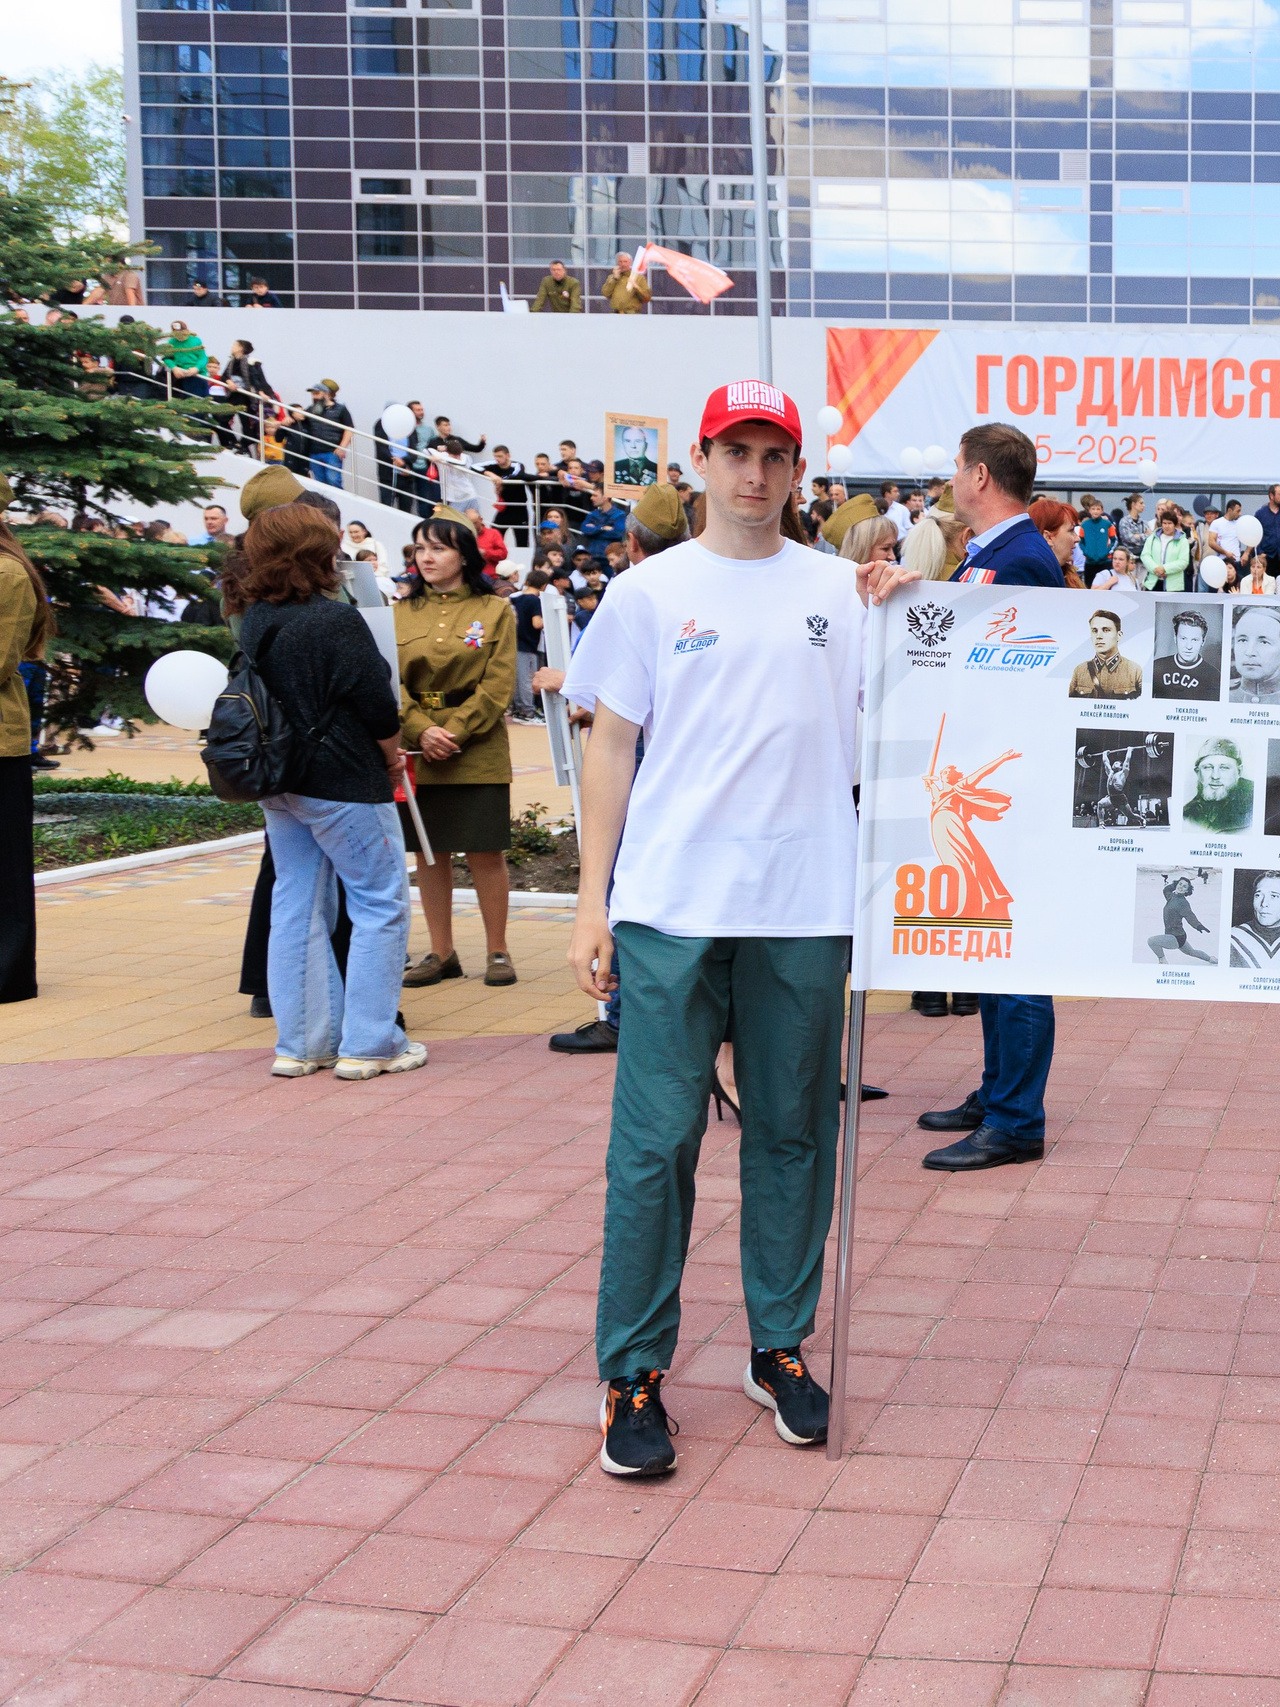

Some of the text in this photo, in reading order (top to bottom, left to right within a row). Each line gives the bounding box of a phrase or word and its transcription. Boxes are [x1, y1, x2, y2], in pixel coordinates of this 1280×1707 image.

[1035, 434, 1158, 464] 5–2025
[907, 650, 952, 658] МИНСПОРТ
[966, 647, 1056, 669] ЮГ Спорт
[912, 660, 946, 668] РОССИИ
[978, 664, 1025, 672] Кисловодске
[1163, 672, 1199, 688] СССР
[894, 864, 960, 917] 80
[892, 928, 1012, 962] ПОБЕДА!
